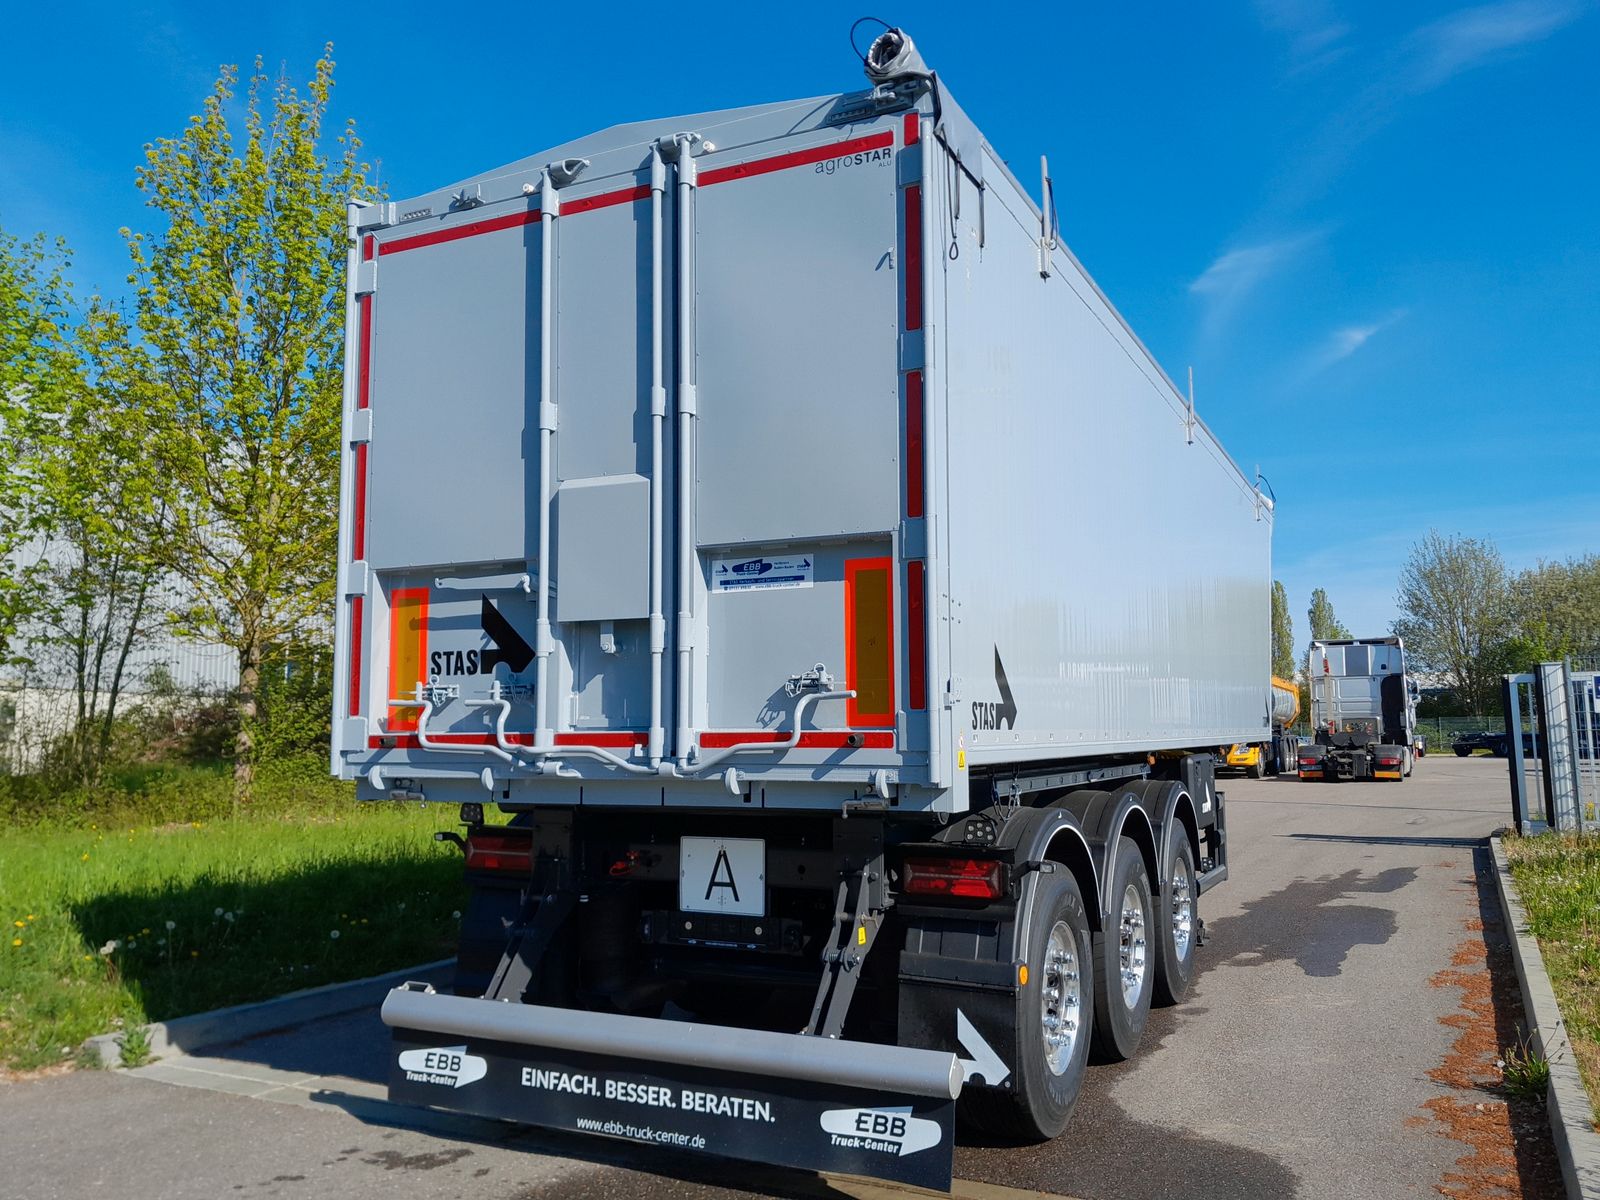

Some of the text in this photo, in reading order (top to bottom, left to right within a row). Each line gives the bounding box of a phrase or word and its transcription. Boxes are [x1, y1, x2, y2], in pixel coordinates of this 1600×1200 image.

[815, 148, 891, 175] agroSTAR
[878, 160, 892, 168] ALU
[743, 563, 761, 571] EBB
[430, 649, 479, 676] STAS
[972, 701, 995, 730] STAS
[704, 849, 740, 902] A
[425, 1052, 462, 1072] EBB
[406, 1071, 455, 1086] Truck-Center
[521, 1067, 776, 1123] EINFACH. BESSER. BERATEN.
[576, 1117, 705, 1149] www.ebb-truck-center.de
[855, 1111, 907, 1138] EBB
[831, 1134, 899, 1153] Truck-Center
